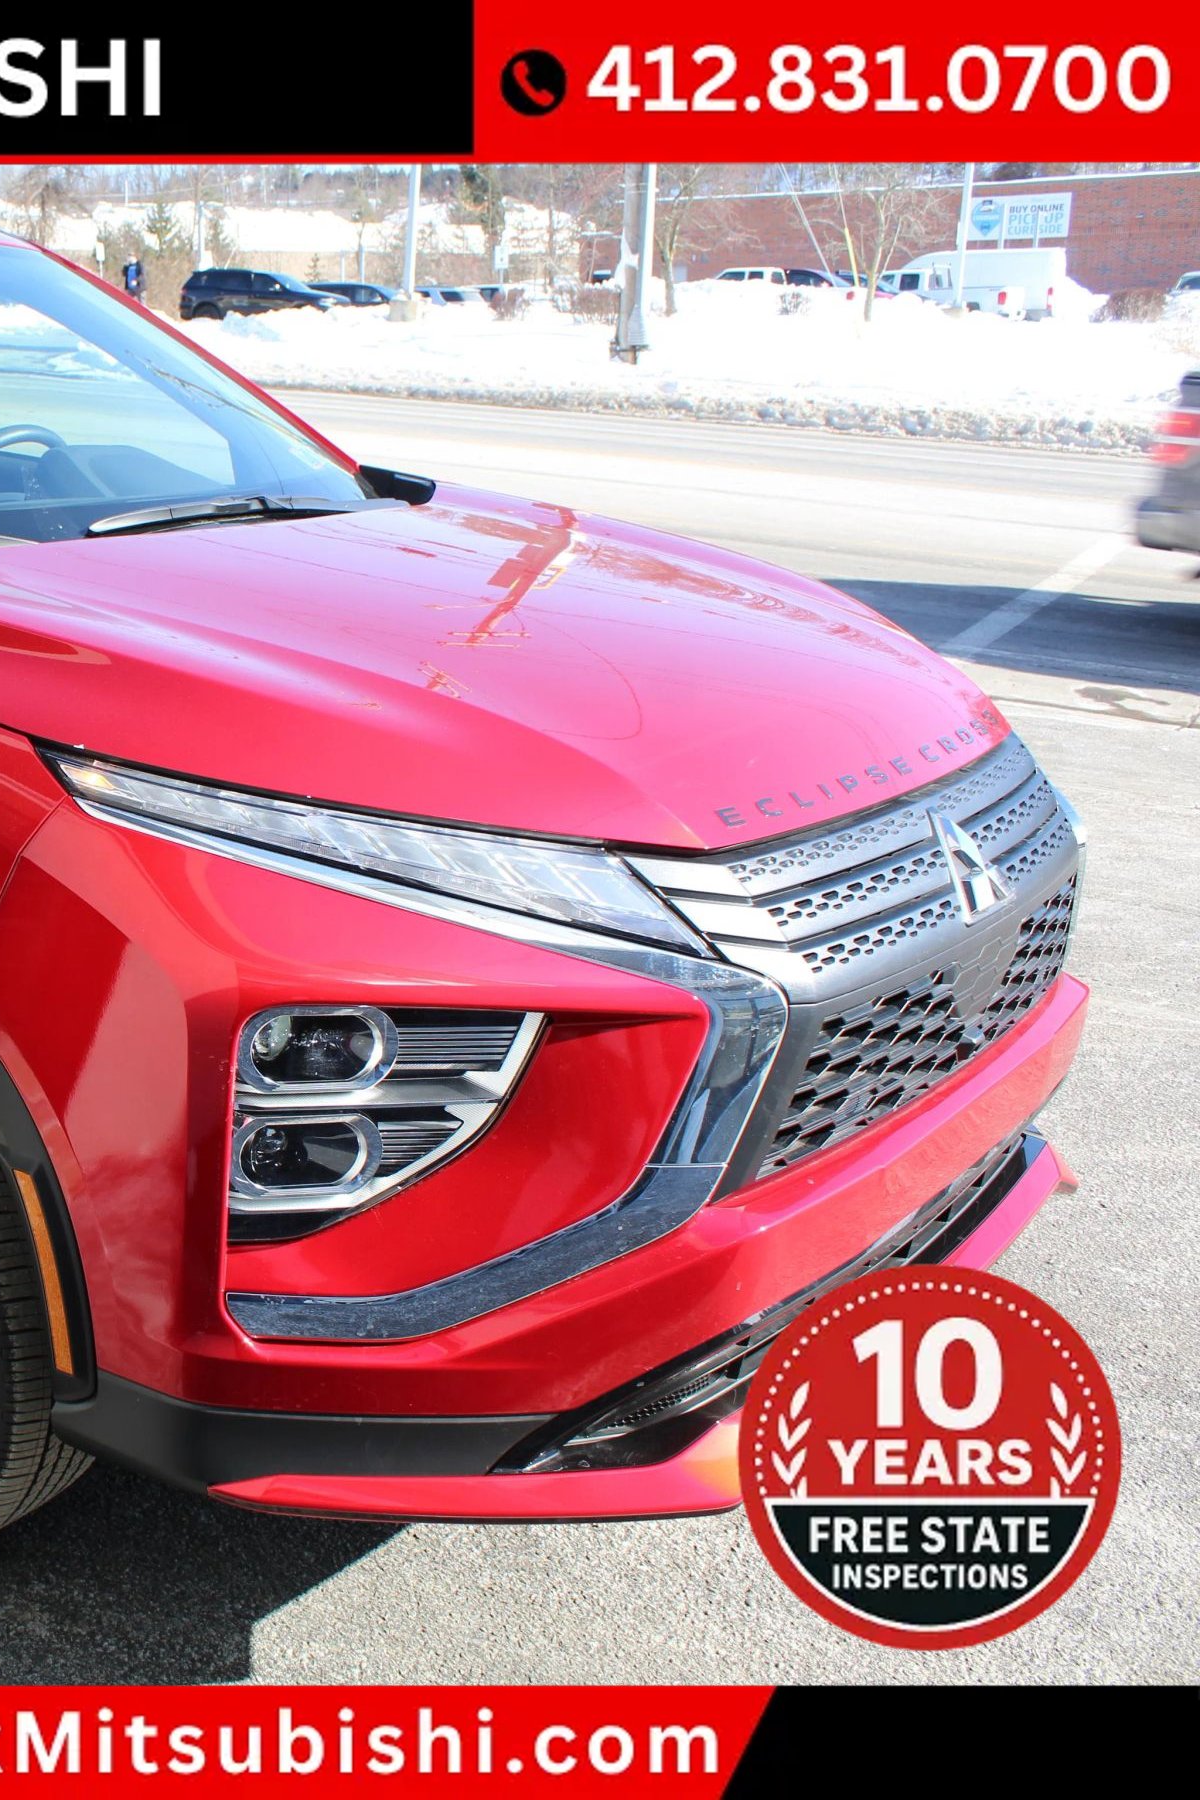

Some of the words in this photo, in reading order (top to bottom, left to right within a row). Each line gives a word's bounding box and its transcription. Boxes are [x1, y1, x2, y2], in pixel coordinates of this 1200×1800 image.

[1009, 205, 1028, 213] BUY
[1030, 203, 1064, 213] ONLINE
[1044, 212, 1064, 224] UP
[714, 755, 913, 828] ECLIPSE
[918, 709, 999, 763] CROSS
